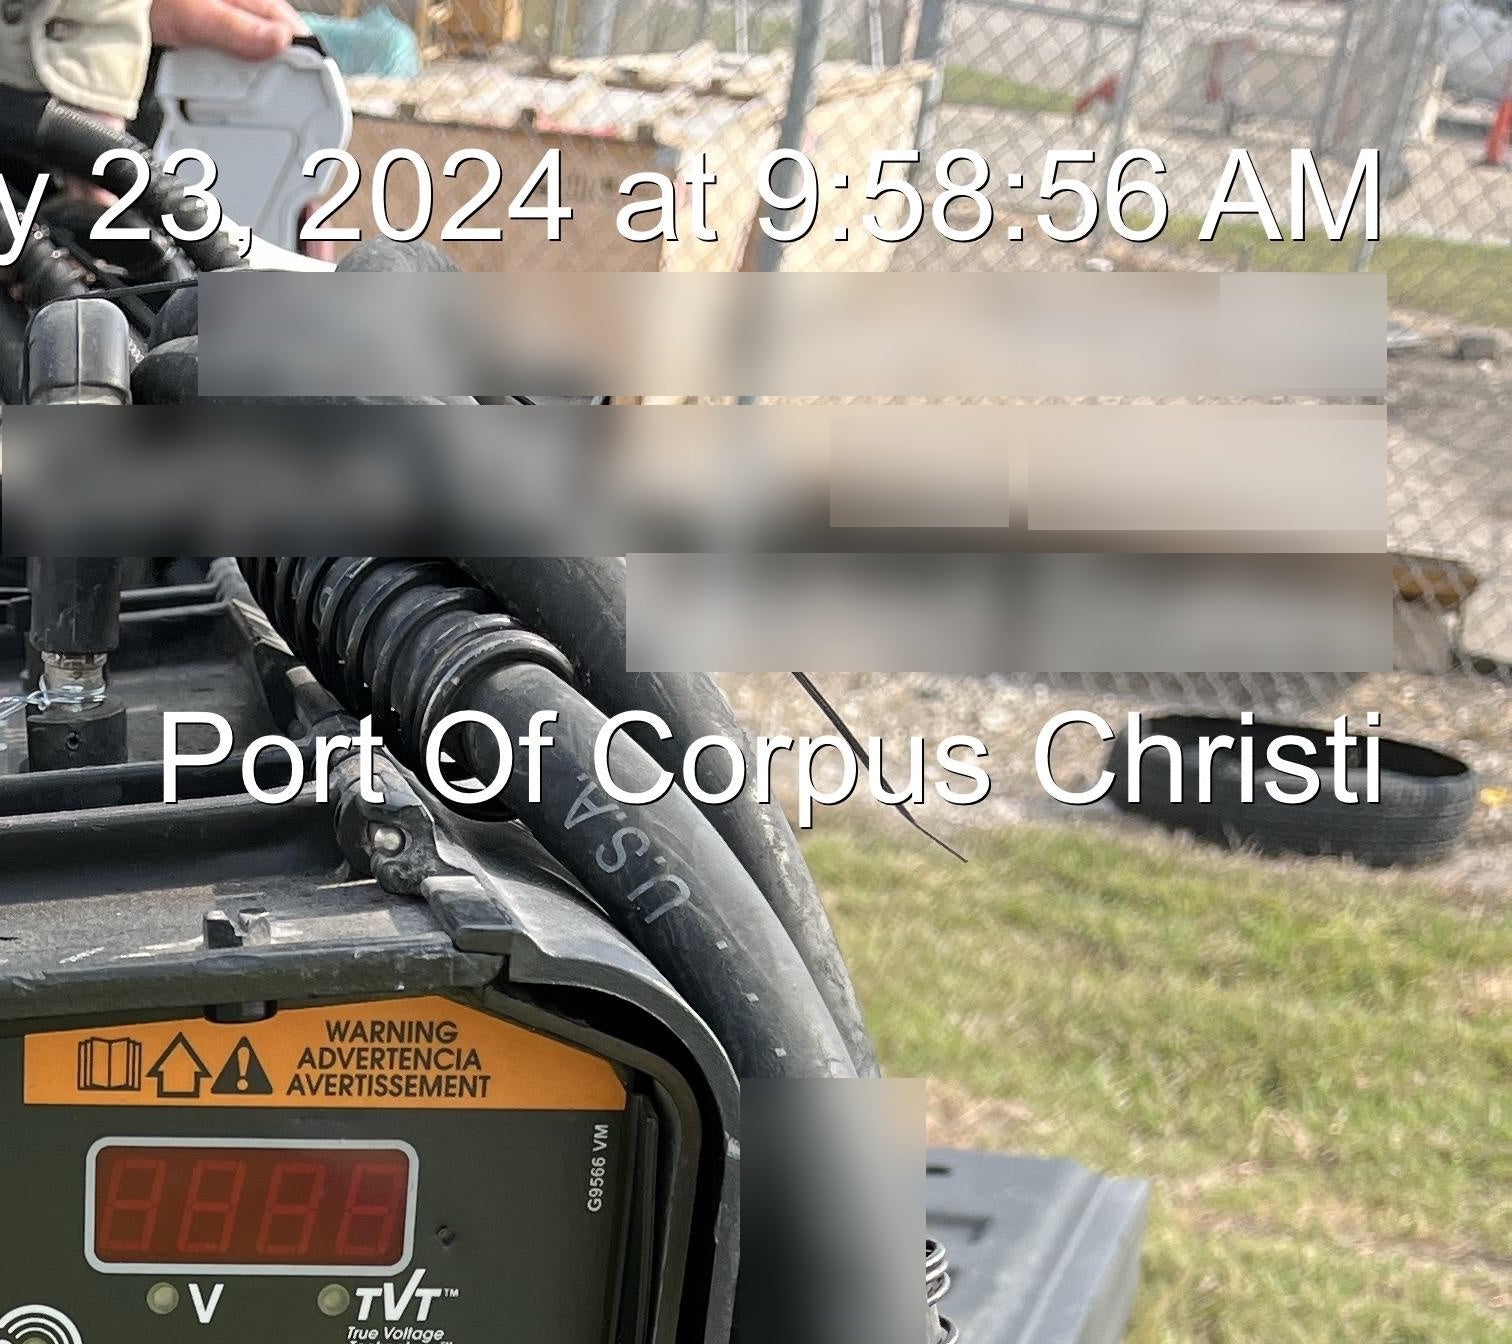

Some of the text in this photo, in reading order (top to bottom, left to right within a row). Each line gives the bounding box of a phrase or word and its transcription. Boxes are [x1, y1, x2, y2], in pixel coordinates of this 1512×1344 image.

[326, 1020, 458, 1043] WARNING
[297, 1047, 482, 1071] ADVERTENCIA
[287, 1074, 491, 1098] AVERTISSEMENT
[587, 1124, 609, 1212] G9566 VM
[188, 1283, 224, 1324] V
[348, 1326, 445, 1344] True Voltage
